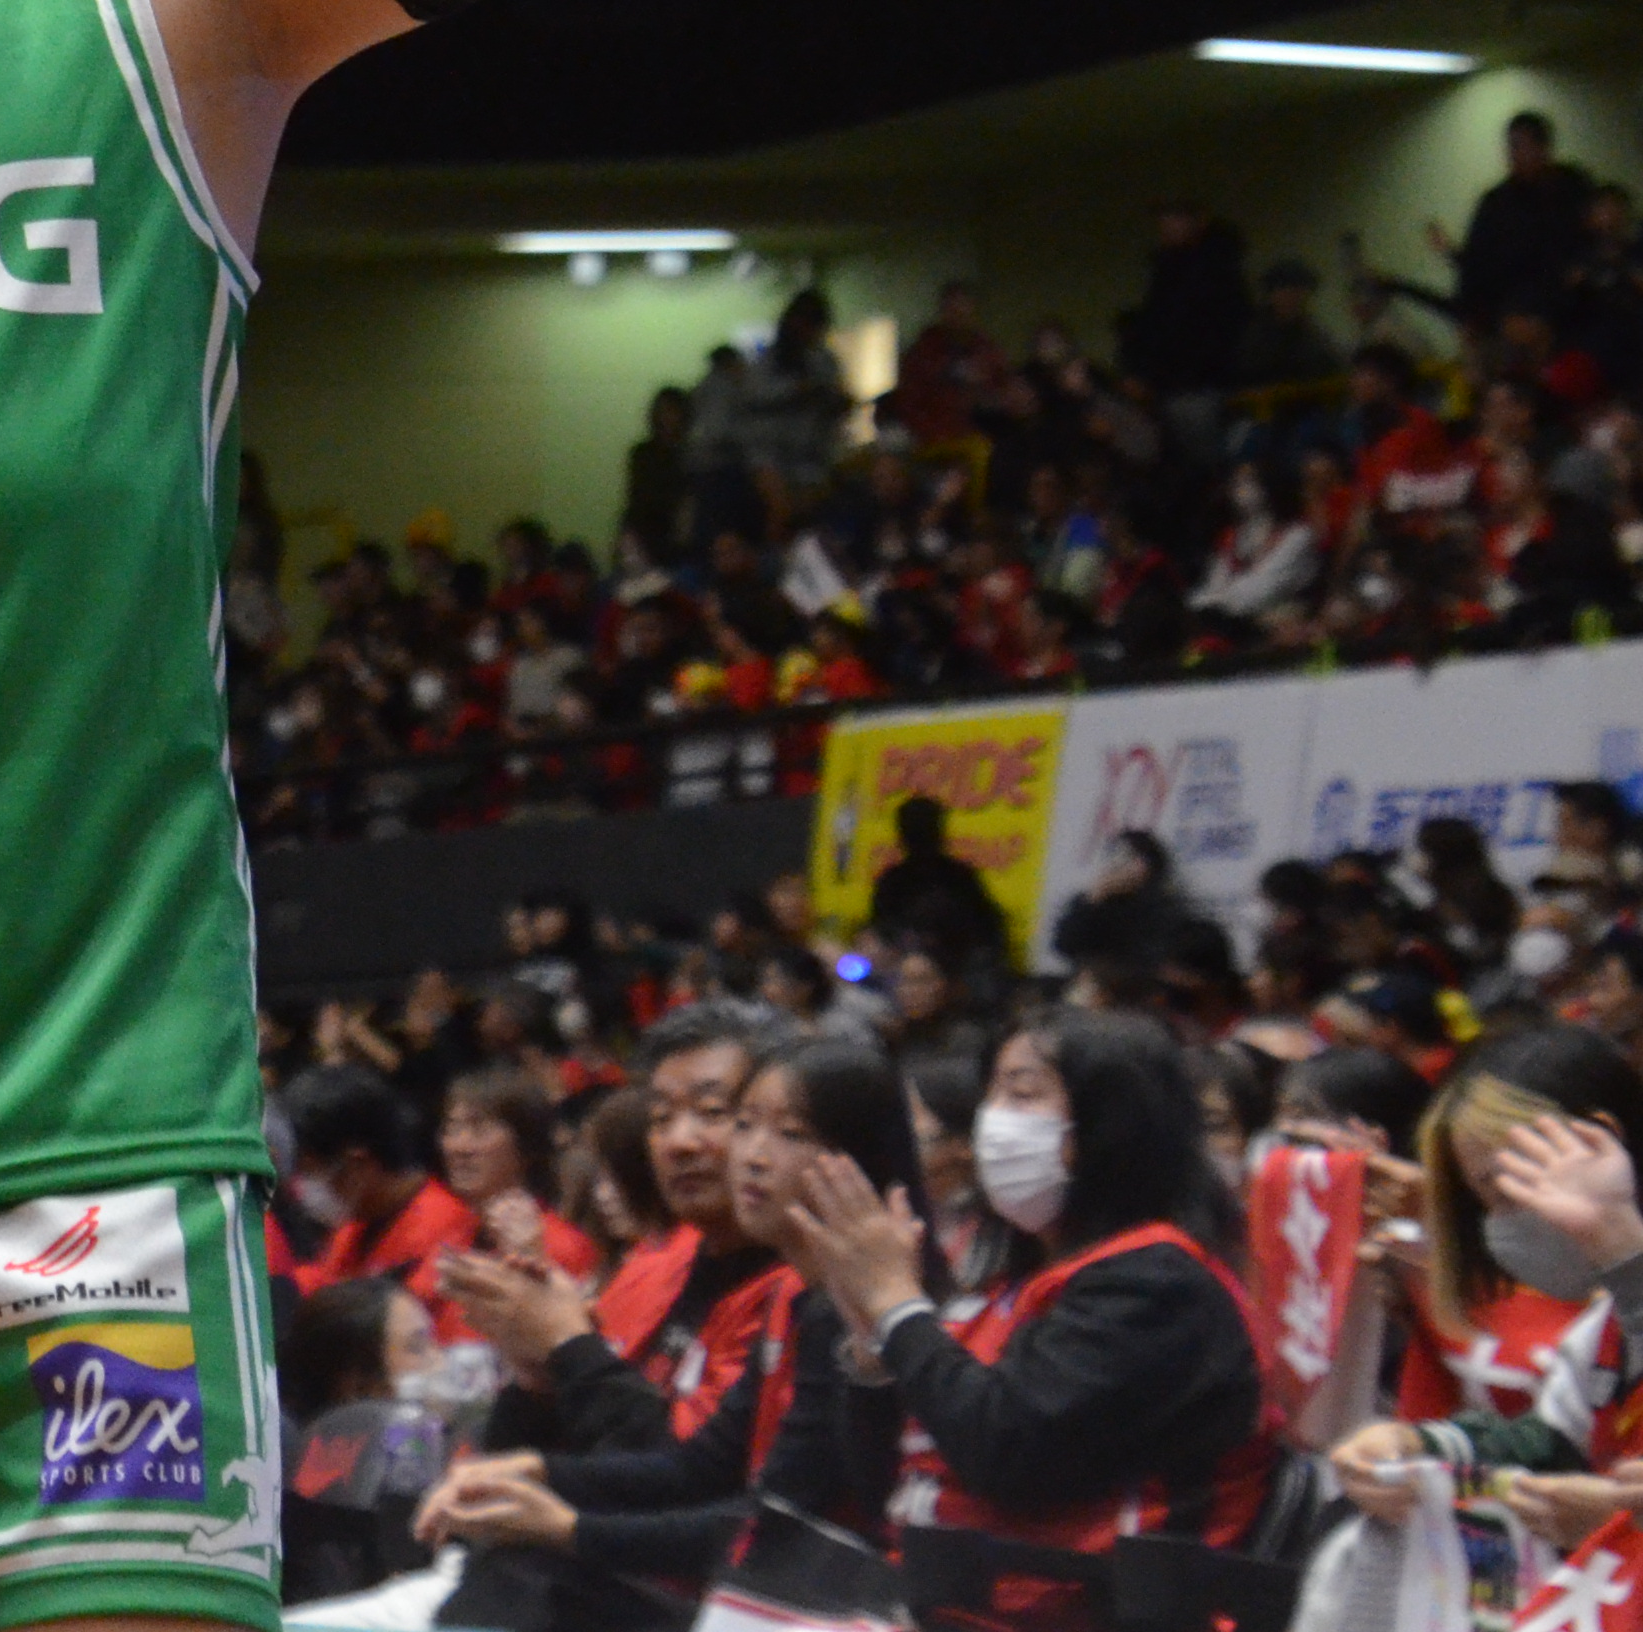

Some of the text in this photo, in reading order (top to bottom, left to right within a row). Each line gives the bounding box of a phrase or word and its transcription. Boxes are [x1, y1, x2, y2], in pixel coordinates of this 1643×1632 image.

[44, 1357, 200, 1462] ilex
[40, 1460, 202, 1490] SPORTS CLUB
